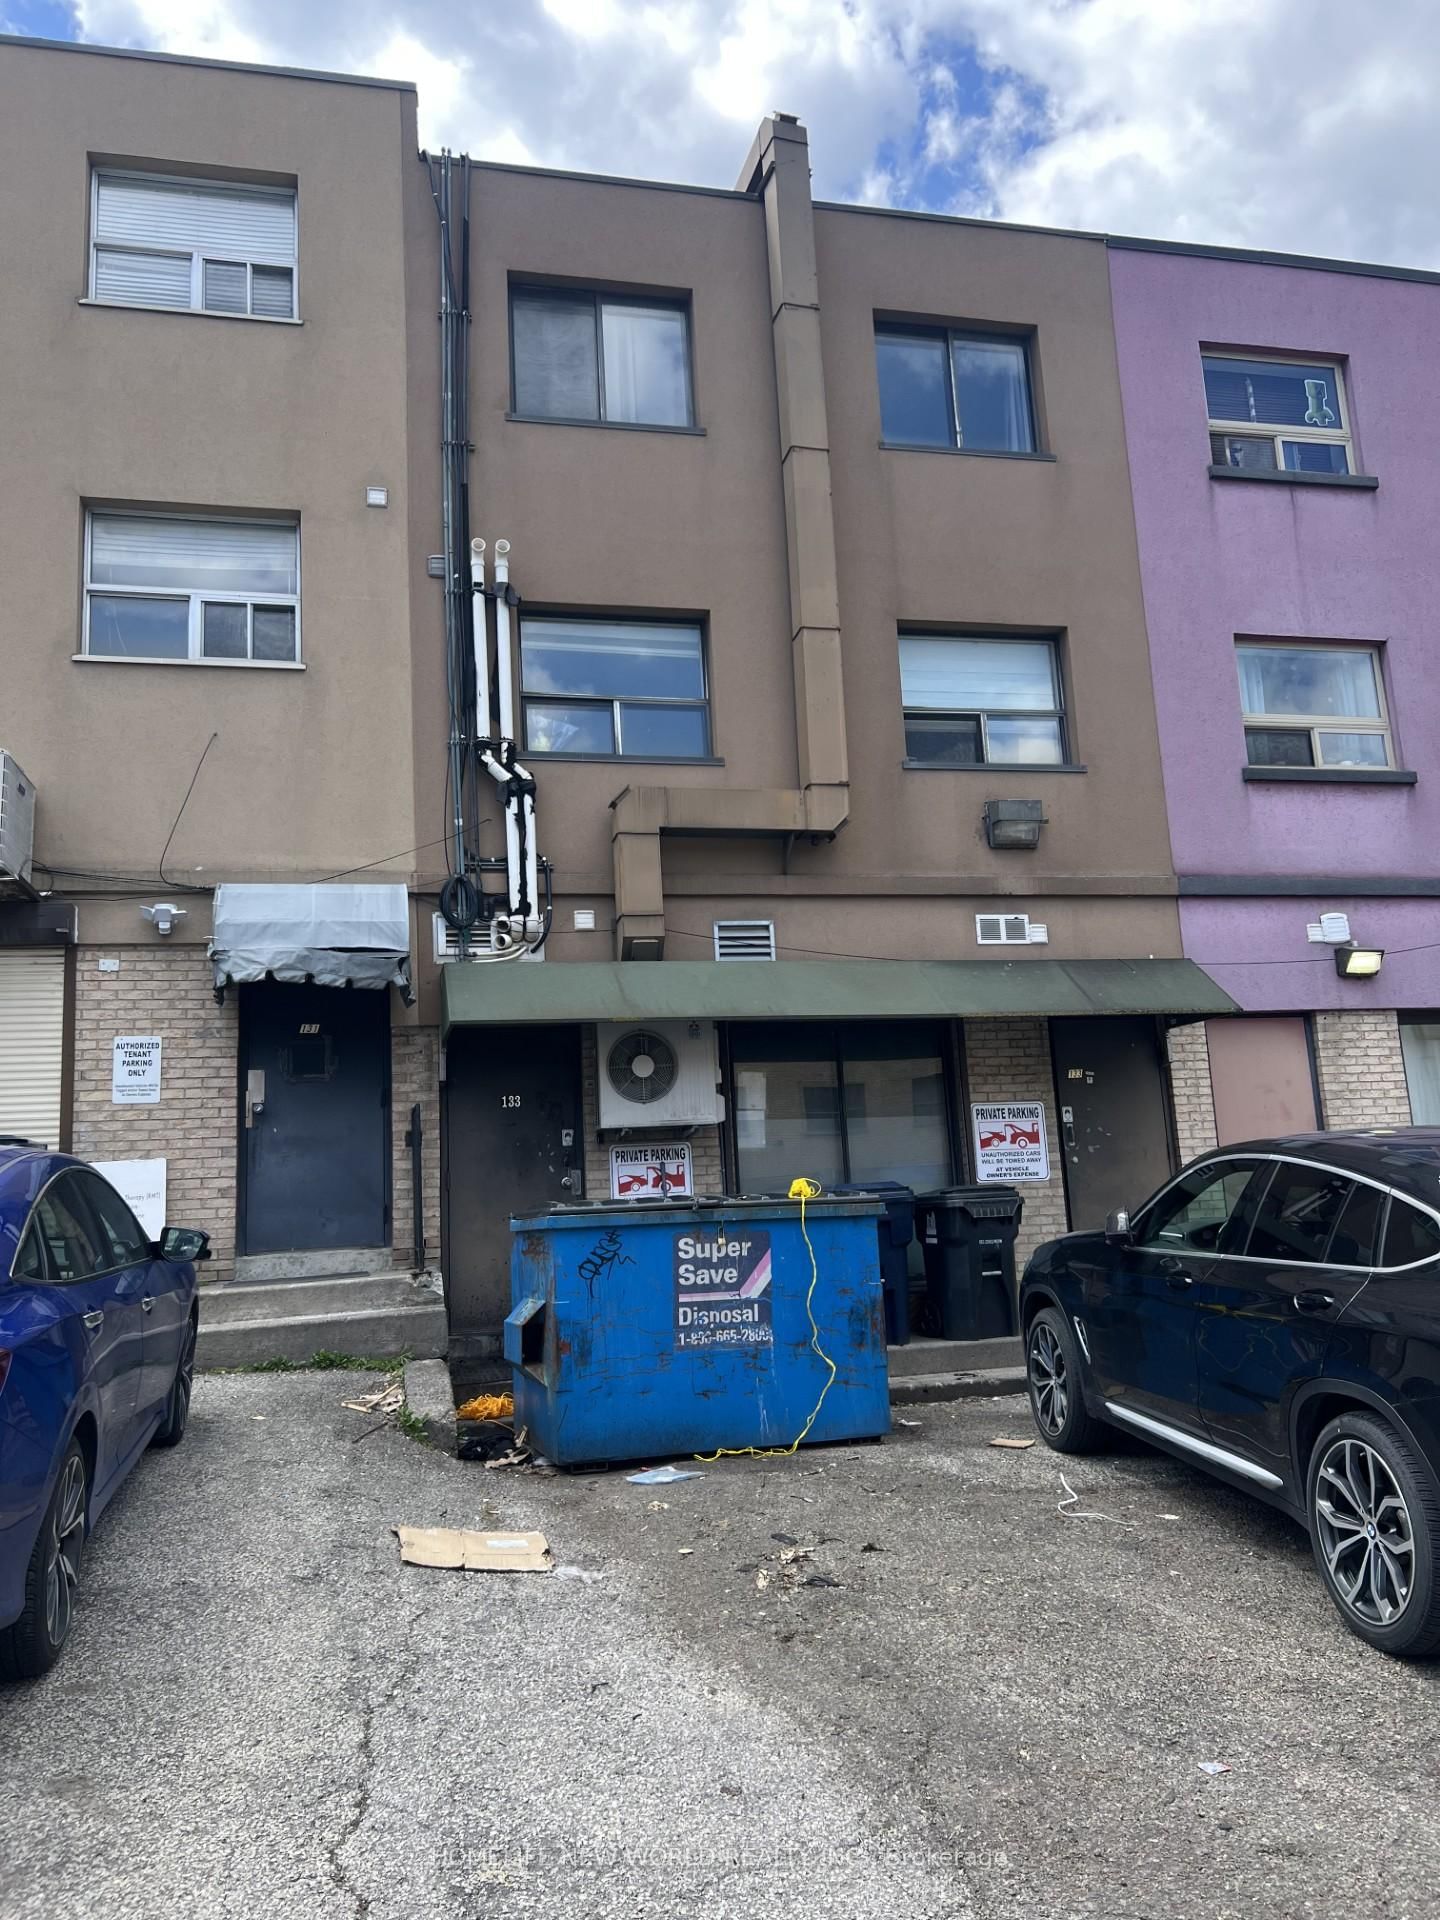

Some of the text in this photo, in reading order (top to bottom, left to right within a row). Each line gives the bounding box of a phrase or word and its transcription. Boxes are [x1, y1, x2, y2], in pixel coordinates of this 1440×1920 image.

[116, 1042, 160, 1050] AUTHORIZED
[501, 1095, 521, 1108] 133
[976, 1106, 1039, 1120] PRIVATE PARKING
[615, 1148, 686, 1163] PRIVATE PARKING
[678, 1237, 752, 1262] Super
[678, 1264, 738, 1286] Save
[678, 1304, 759, 1328] Disposal
